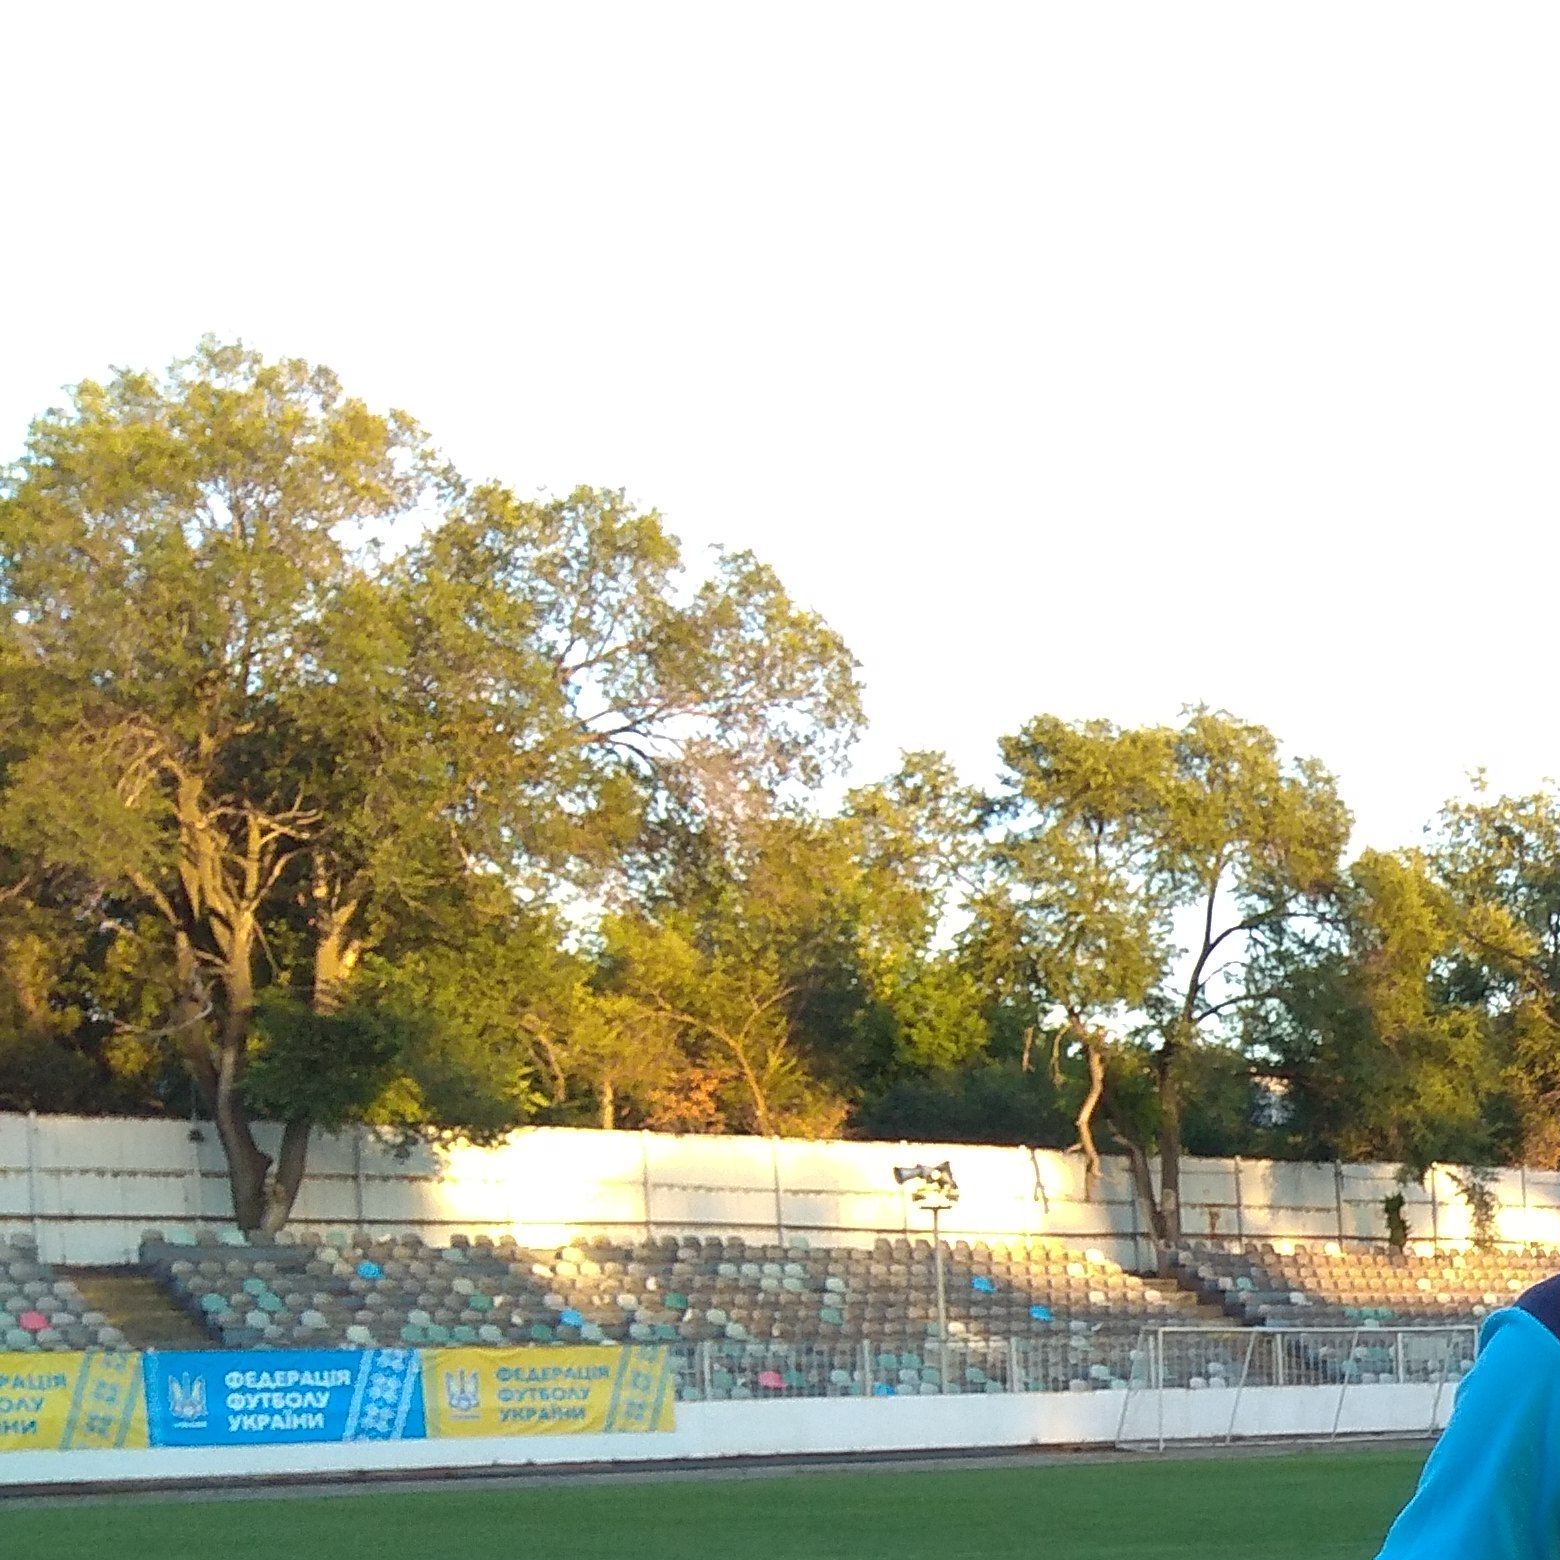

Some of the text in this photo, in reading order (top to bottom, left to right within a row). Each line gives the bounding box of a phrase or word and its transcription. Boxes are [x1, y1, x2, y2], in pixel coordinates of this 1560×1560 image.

[225, 1369, 351, 1389] ФЕДЕРАЦІЯ
[496, 1367, 608, 1382] ФЕДЕРАЦІЯ
[226, 1390, 330, 1410] ФУТБОЛУ
[498, 1387, 588, 1401] ФУТБОЛУ
[228, 1409, 324, 1431] УКРАЇНИ
[499, 1404, 585, 1421] УКРАЇНИ
